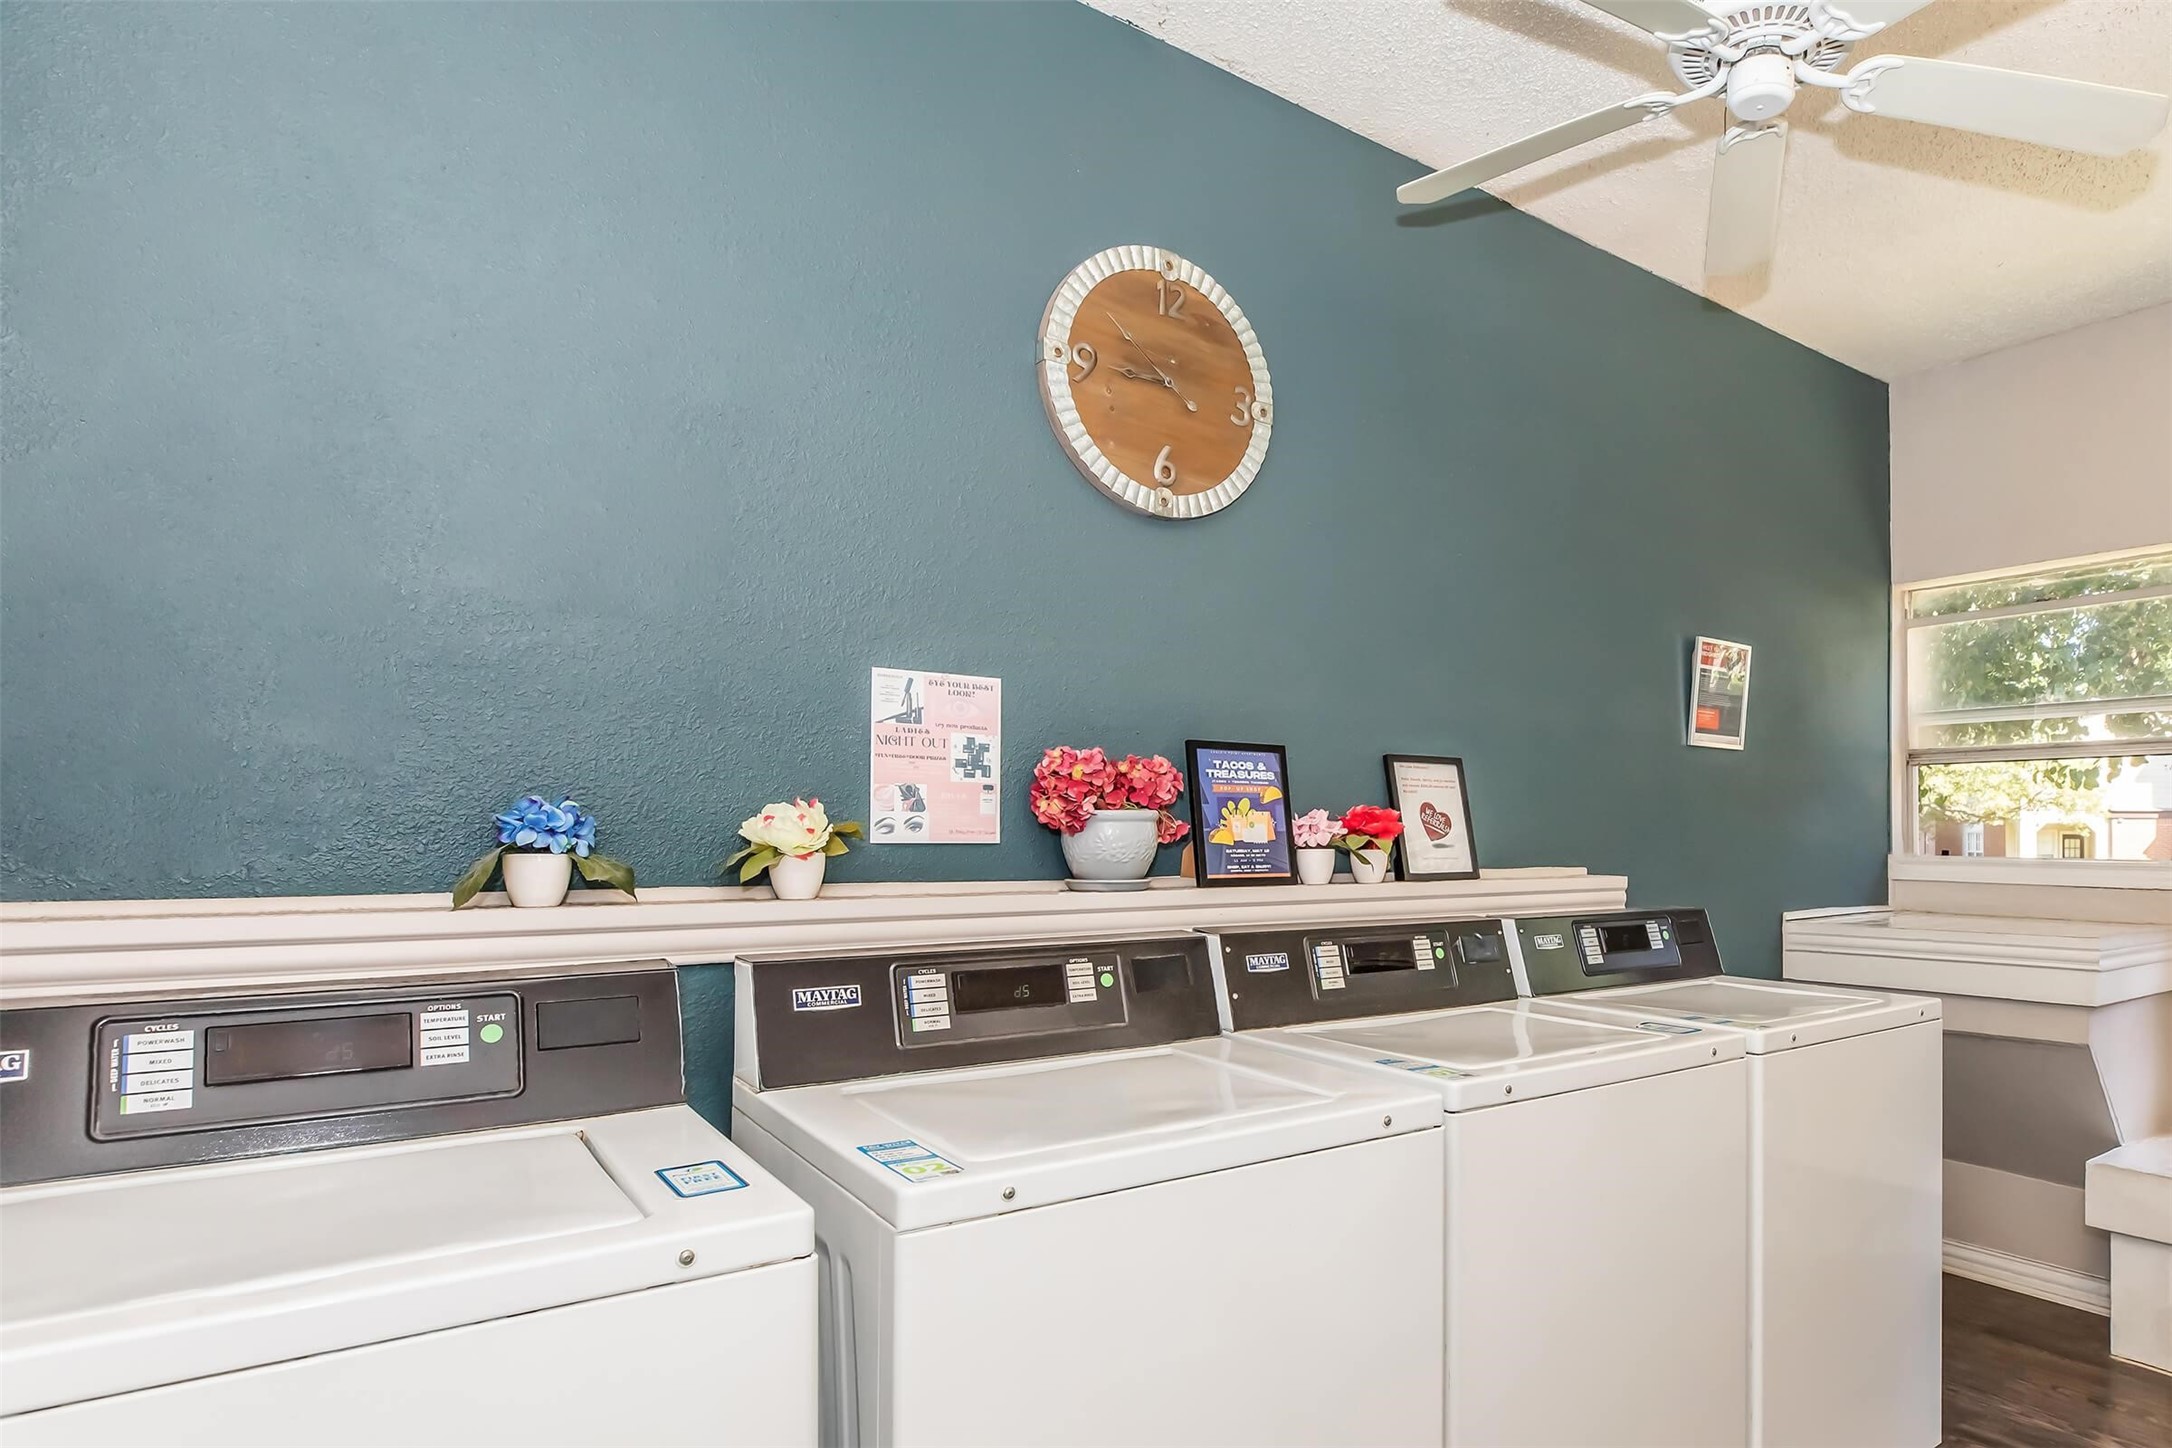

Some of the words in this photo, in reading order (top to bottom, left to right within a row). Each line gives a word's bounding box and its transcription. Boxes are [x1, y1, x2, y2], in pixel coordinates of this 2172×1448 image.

[1156, 279, 1186, 321] 12
[1072, 343, 1098, 384] 9
[1230, 386, 1251, 427] 3
[1154, 445, 1176, 486] 6
[947, 681, 971, 690] YOUR
[947, 689, 976, 698] LOOK!
[895, 726, 930, 735] LADIES
[875, 734, 917, 747] NIGHT
[921, 736, 949, 749] OUT
[1213, 759, 1254, 770] TACOS
[1257, 762, 1266, 771] &
[1205, 768, 1275, 781] TREASURES
[1425, 807, 1434, 817] WE
[1434, 812, 1447, 825] LOVE
[1535, 936, 1562, 945] MAYTAG
[1249, 954, 1286, 967] MAYTAG
[1097, 965, 1114, 973] START
[797, 987, 857, 1004] MAYTAG
[427, 1003, 462, 1012] OPTIONS
[807, 999, 848, 1008] COMMERCIAL
[423, 1015, 466, 1024] TEMPERATURE
[477, 1013, 506, 1023] START
[144, 1023, 180, 1033] CYCLES
[137, 1037, 185, 1046] POWERWASH
[426, 1053, 446, 1061] EXTRA
[447, 1051, 464, 1059] RINSE
[140, 1078, 180, 1087] DELICATES
